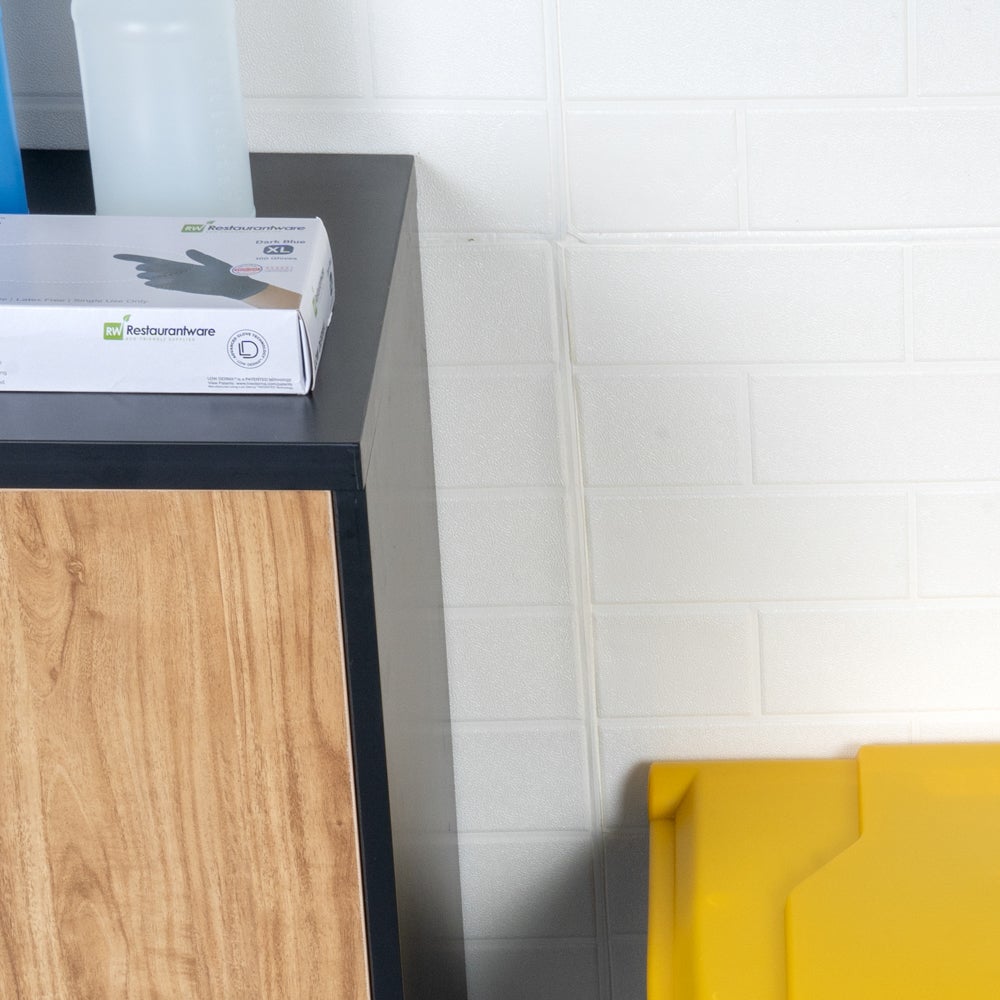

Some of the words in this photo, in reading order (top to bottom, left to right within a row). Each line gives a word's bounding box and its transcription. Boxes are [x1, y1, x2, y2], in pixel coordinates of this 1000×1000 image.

[207, 224, 306, 232] Restaurantware
[266, 246, 290, 254] XL
[105, 326, 122, 336] RW
[126, 324, 216, 338] Restaurantware
